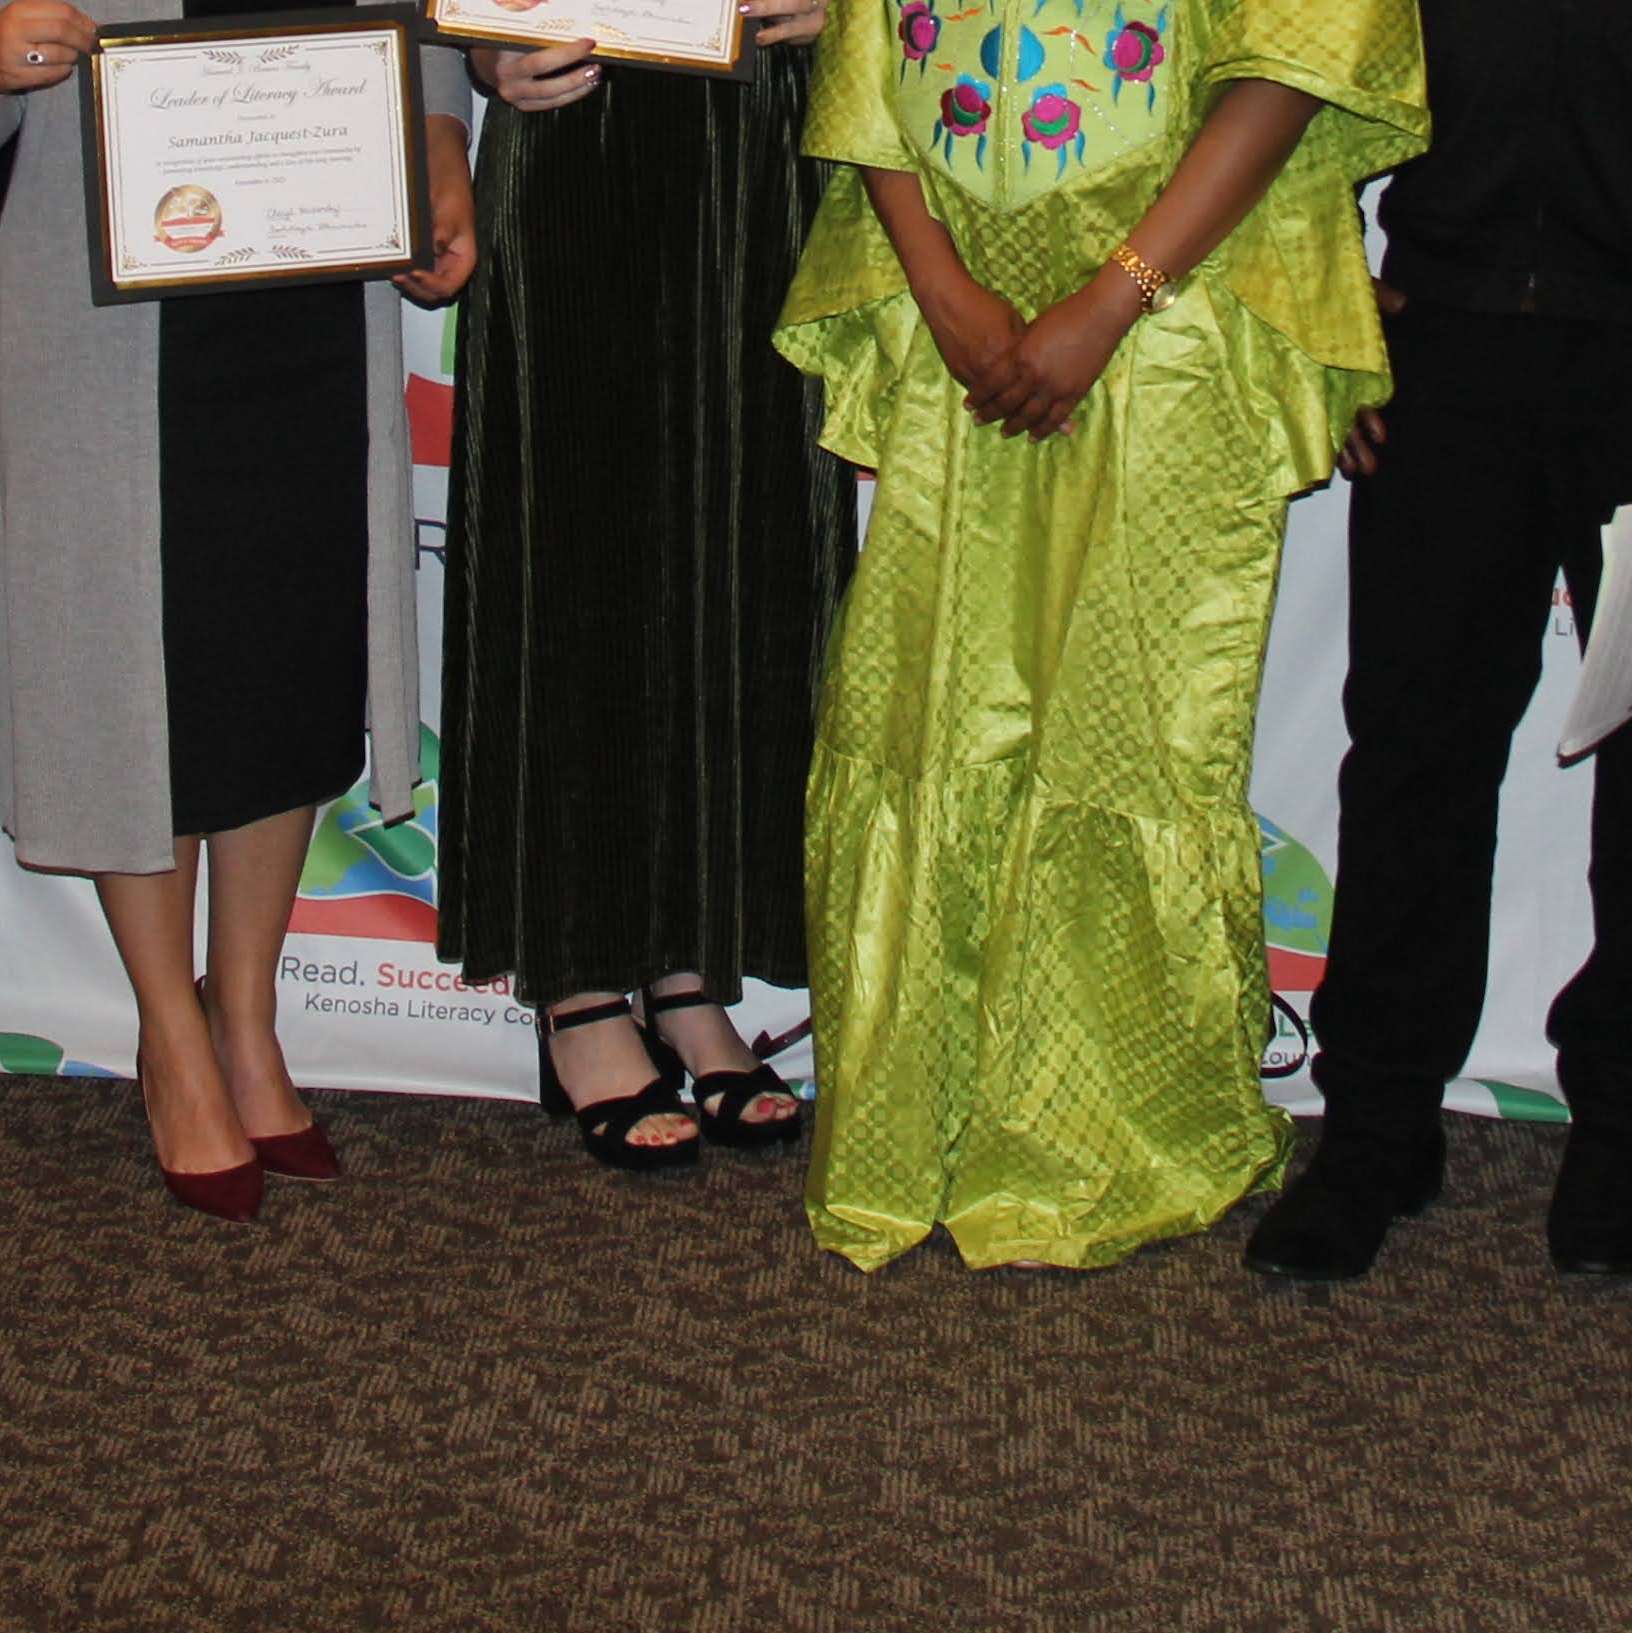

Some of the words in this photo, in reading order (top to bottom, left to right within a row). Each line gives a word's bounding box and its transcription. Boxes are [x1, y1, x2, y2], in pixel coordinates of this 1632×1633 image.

[147, 86, 209, 111] Leader
[212, 92, 230, 112] of
[230, 83, 299, 106] Literacy
[303, 77, 369, 99] Award
[167, 129, 244, 149] Samantha
[280, 956, 365, 987] Read.
[304, 992, 400, 1017] Kenosha
[407, 999, 496, 1026] Literacy
